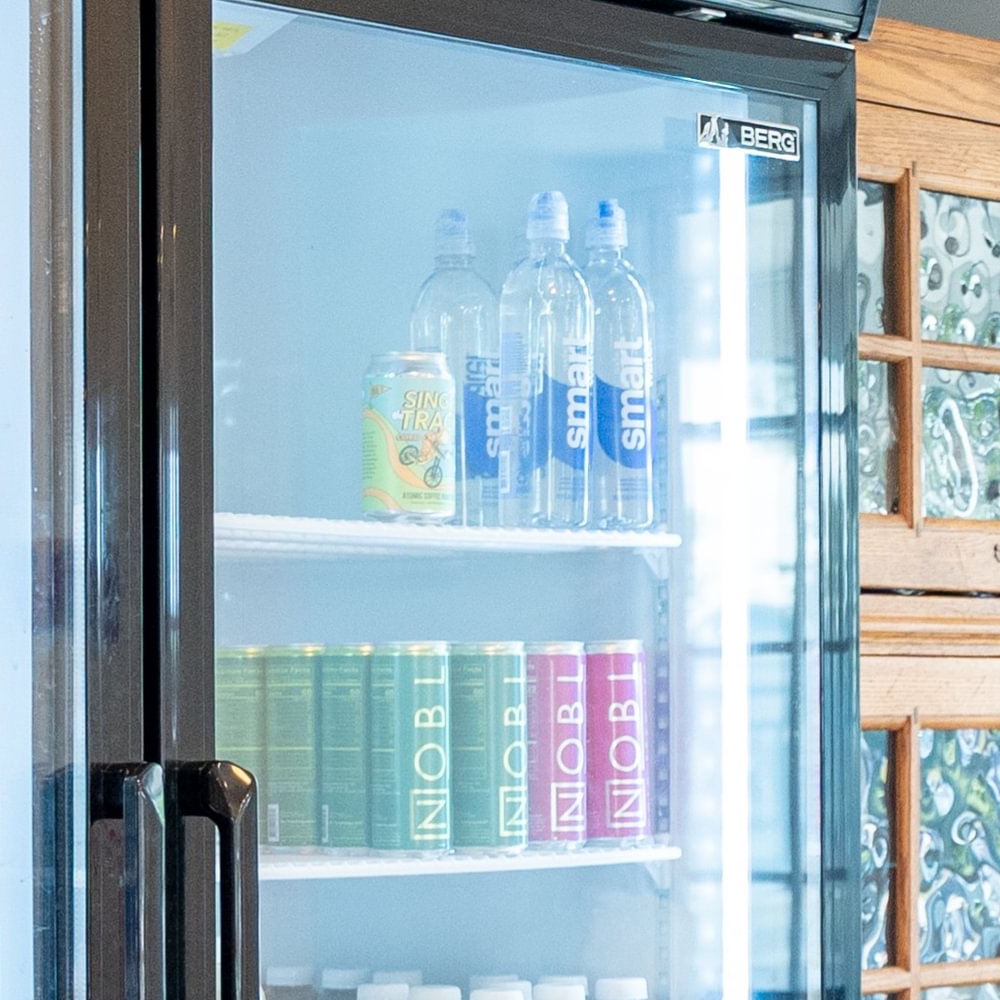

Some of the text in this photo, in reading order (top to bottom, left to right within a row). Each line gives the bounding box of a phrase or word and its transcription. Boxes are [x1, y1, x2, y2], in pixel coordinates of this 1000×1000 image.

[741, 126, 795, 153] BERG
[562, 336, 590, 450] smart
[614, 335, 647, 451] smart
[605, 661, 647, 829] NOBL
